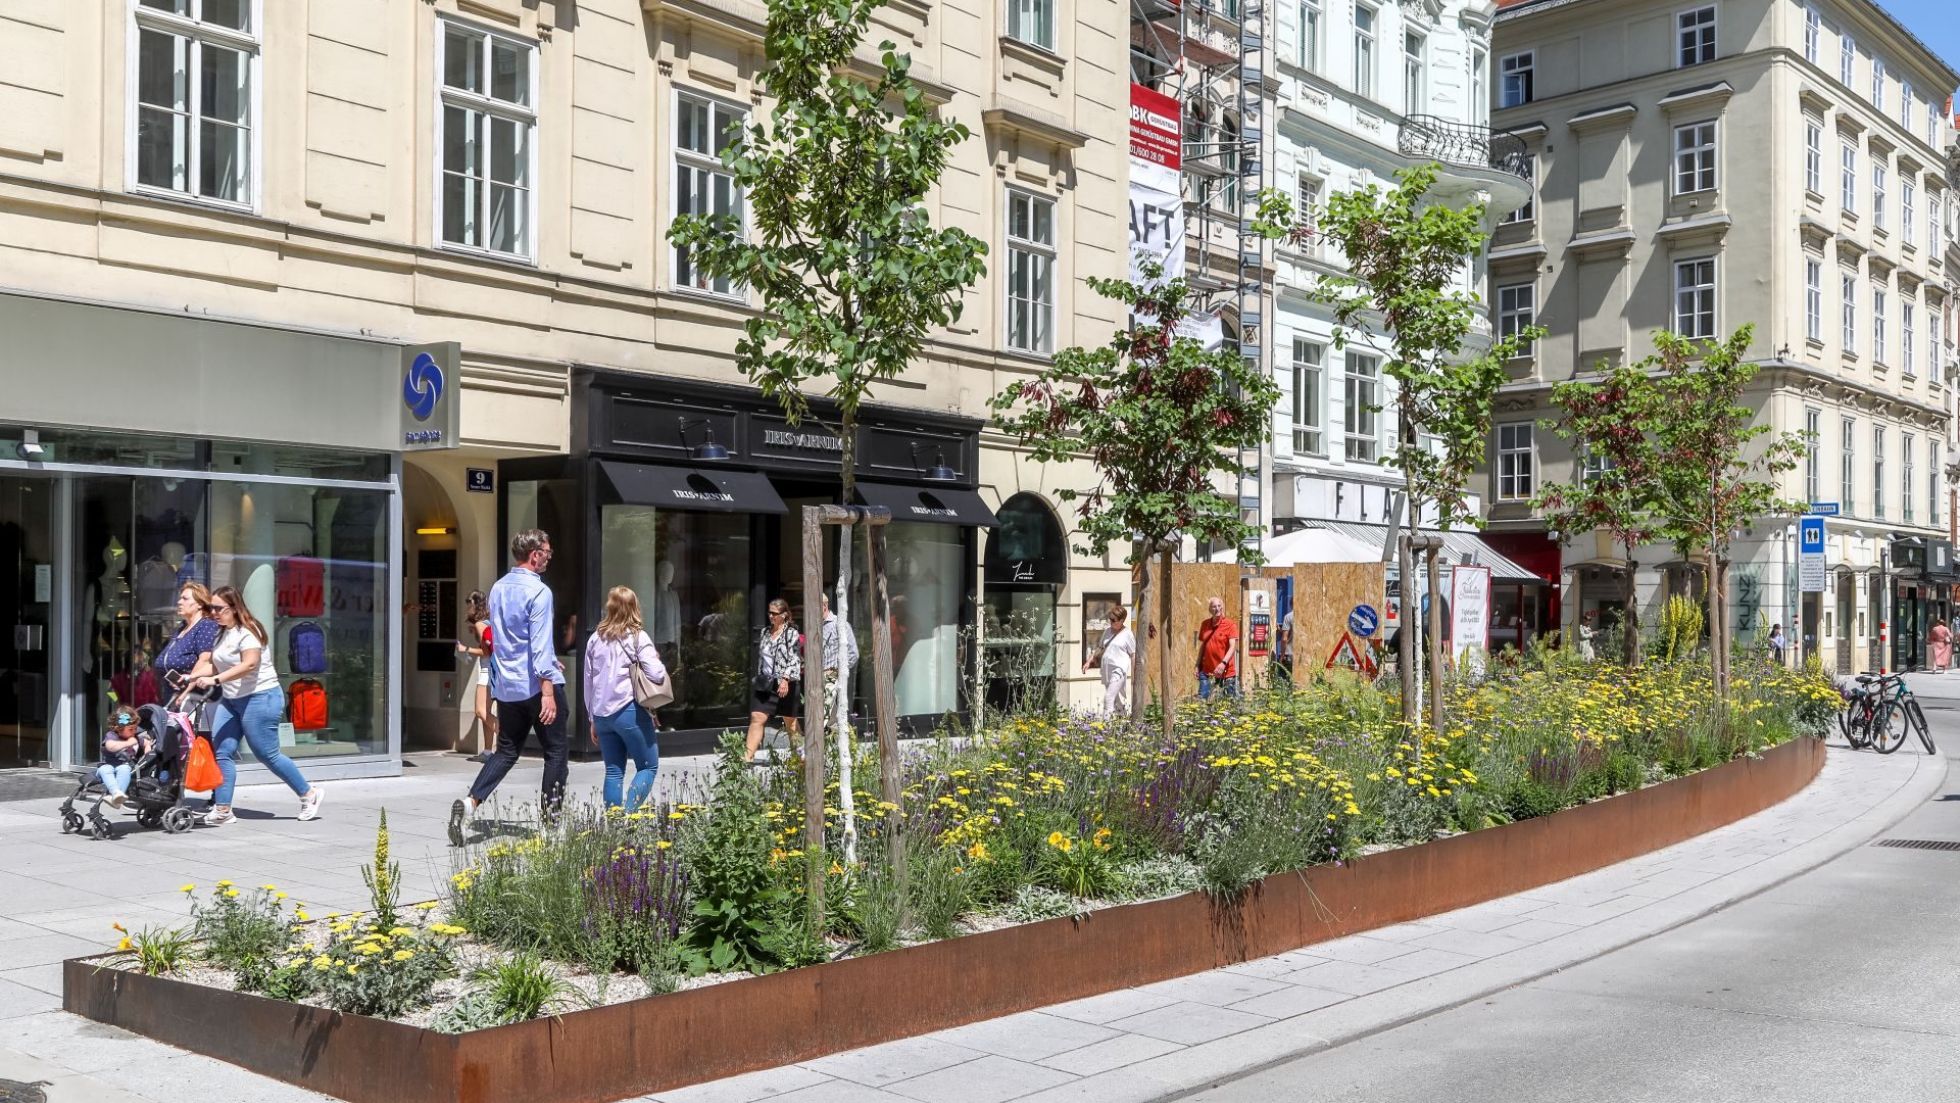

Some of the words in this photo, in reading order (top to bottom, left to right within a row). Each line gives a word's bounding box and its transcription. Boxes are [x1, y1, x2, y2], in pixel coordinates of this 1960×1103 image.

[1129, 104, 1148, 125] BK
[475, 471, 486, 485] 9
[1738, 575, 1751, 632] KUNZ
